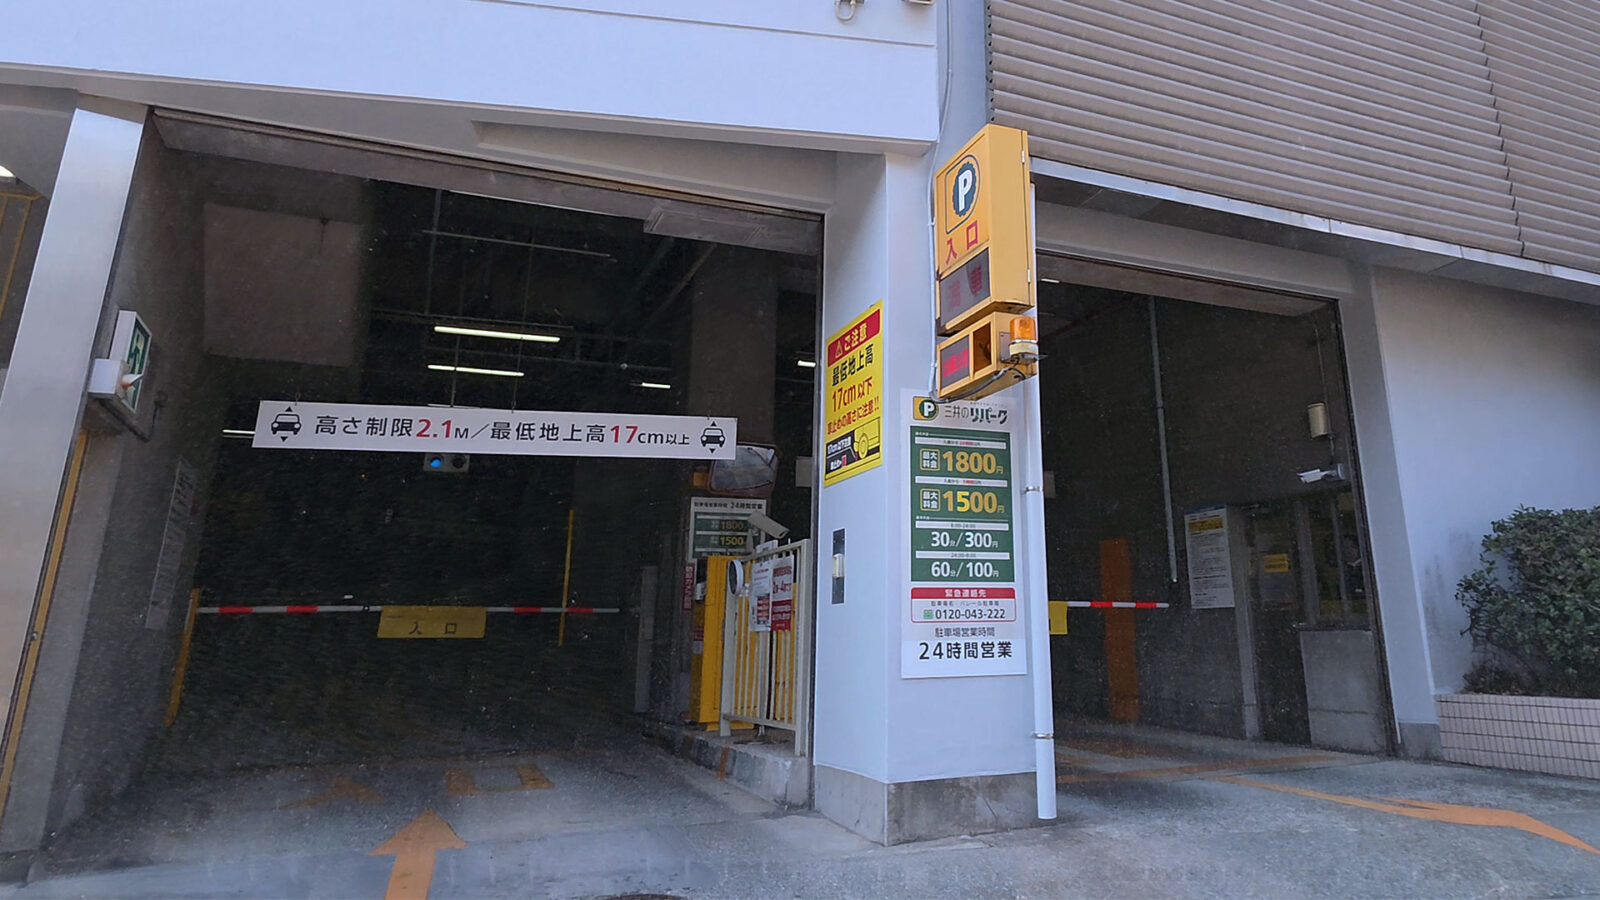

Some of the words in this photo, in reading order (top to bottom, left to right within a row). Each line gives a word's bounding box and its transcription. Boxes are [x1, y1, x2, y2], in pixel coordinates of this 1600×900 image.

[958, 169, 973, 213] P
[946, 219, 979, 265] 入口
[844, 322, 868, 351] ご注意
[832, 343, 874, 387] 最低地上高
[832, 376, 873, 412] 17cm以下
[944, 405, 1008, 425] 三井のリパーク
[942, 450, 1004, 475] 1800円
[943, 490, 1005, 514] 1500円
[935, 608, 1006, 620] 0120-043-222
[408, 621, 458, 635] 入口
[934, 627, 996, 638] 駐車場営業時間
[918, 640, 1013, 660] 24時間営業
